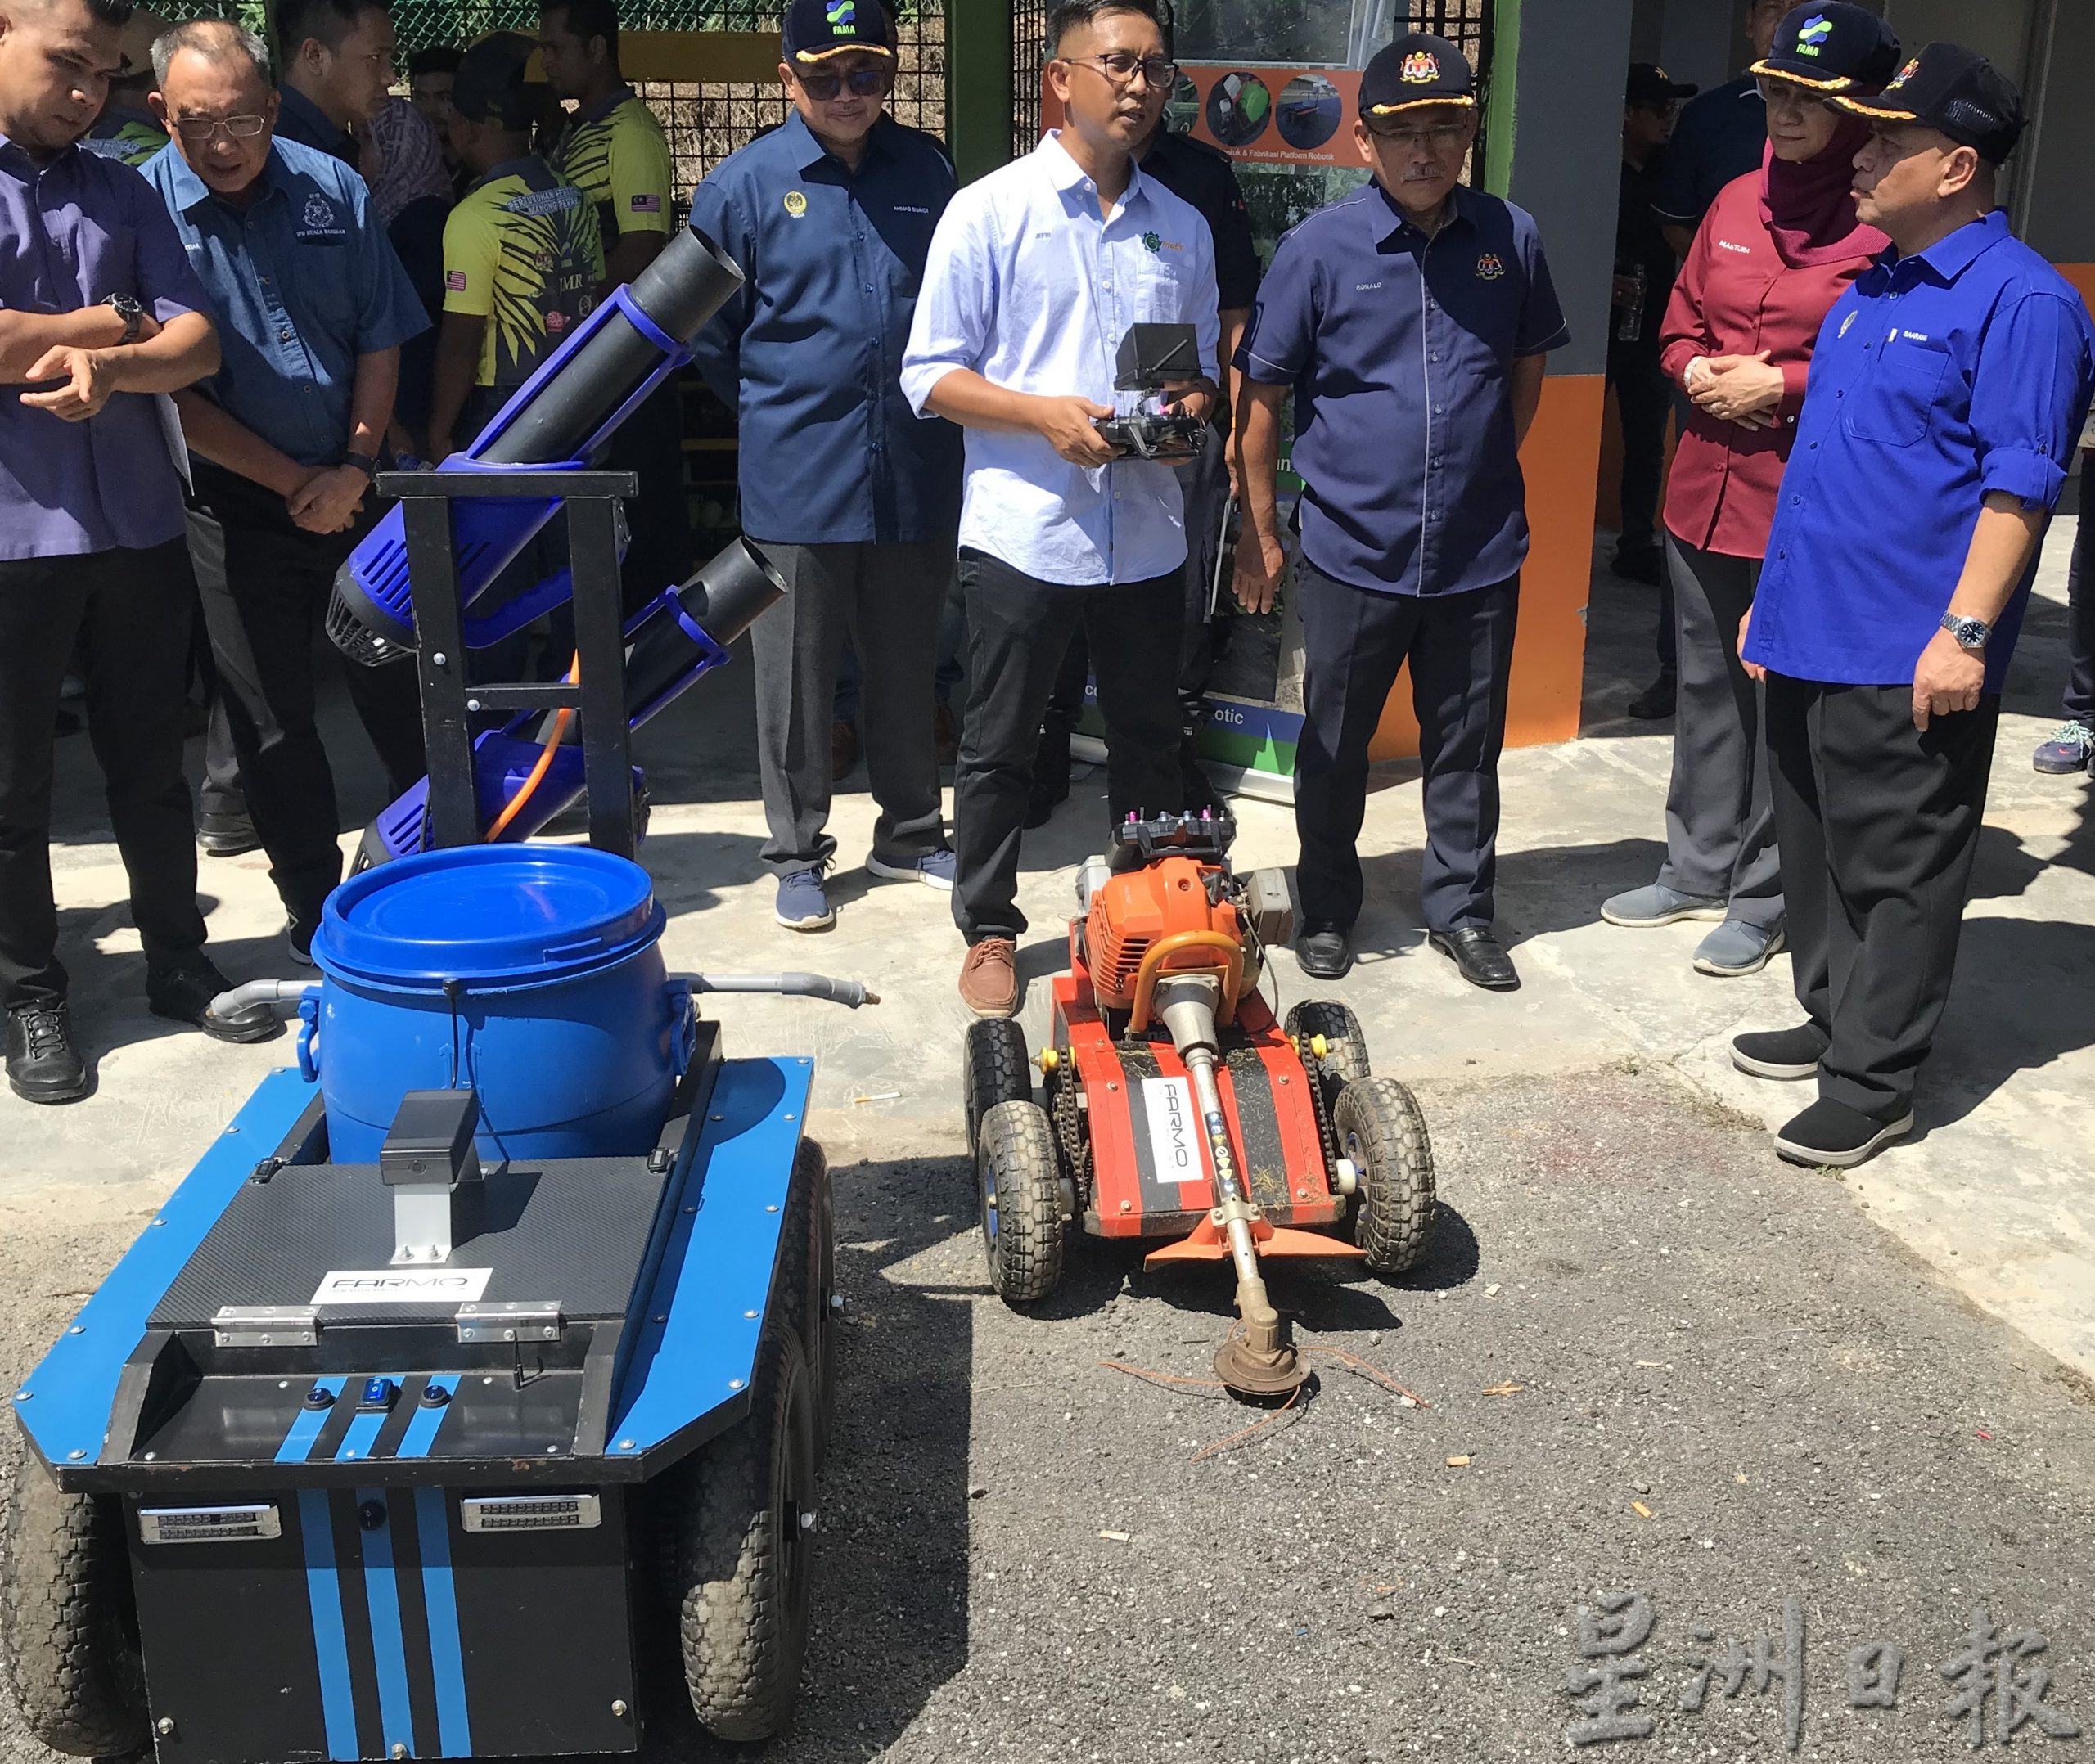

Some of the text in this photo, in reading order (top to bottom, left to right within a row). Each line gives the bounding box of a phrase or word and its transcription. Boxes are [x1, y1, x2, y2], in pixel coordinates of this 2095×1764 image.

[832, 25, 856, 34] FAMA
[1795, 43, 1819, 57] FAMA
[1249, 150, 1279, 158] Fabrikasi
[1280, 151, 1308, 160] Platform
[1308, 152, 1335, 160] Robotik
[1719, 239, 1750, 254] MASTURA
[1355, 281, 1382, 290] RONALD
[1214, 708, 1244, 725] otic
[1164, 1084, 1188, 1168] FARMO
[332, 1277, 468, 1289] FARMO
